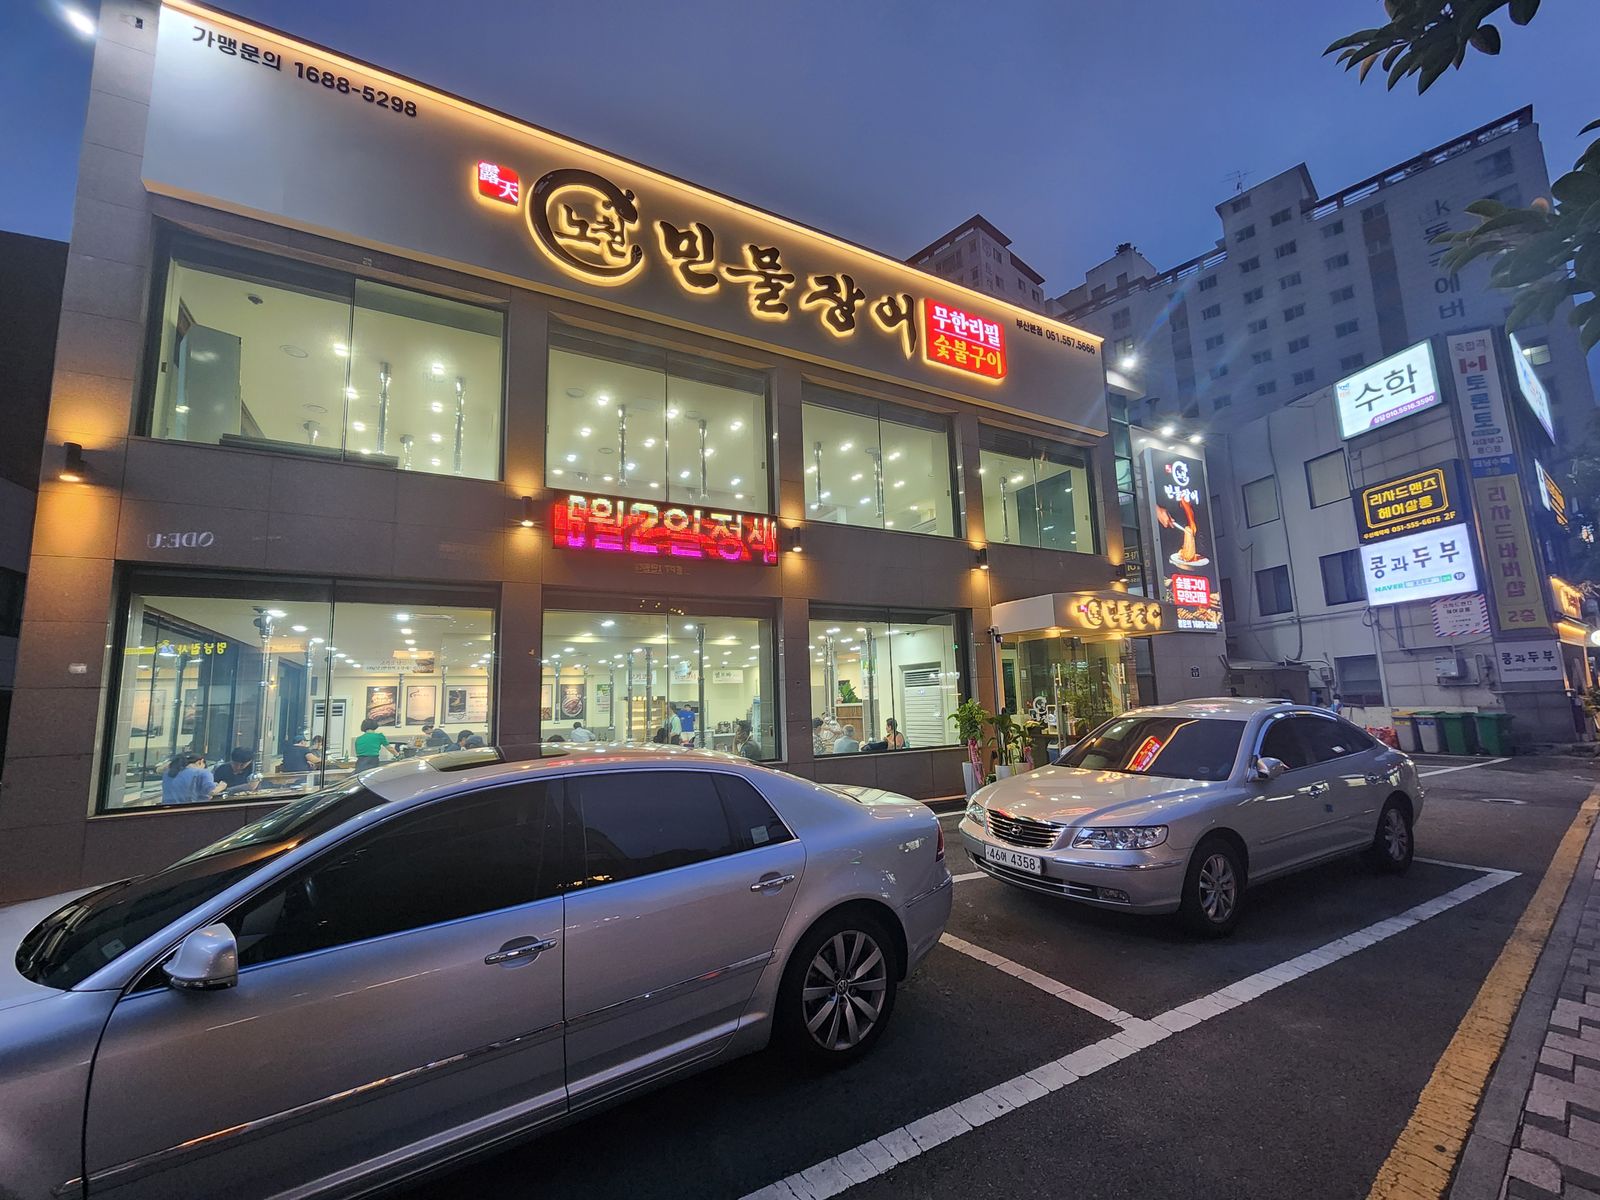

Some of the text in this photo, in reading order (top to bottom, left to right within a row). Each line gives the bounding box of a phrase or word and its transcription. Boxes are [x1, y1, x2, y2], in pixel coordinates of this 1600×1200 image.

[192, 26, 418, 118] 가맹문의 1688-5298
[932, 305, 1001, 347] 무한리필
[1016, 318, 1043, 337] 부산본점
[933, 334, 1003, 375] 숯불구이
[1355, 363, 1418, 412] 수학
[1466, 374, 1494, 429] 토론토
[1369, 477, 1438, 506] 리차드맨즈
[1444, 511, 1456, 520] 2F
[1370, 540, 1460, 579] 콩과두부
[1175, 576, 1206, 591] 숯불구이
[1375, 583, 1404, 592] NAVER
[1177, 590, 1208, 604] 무한리필
[1507, 608, 1536, 623] 2층
[1501, 650, 1555, 665] 콩과두부
[1010, 853, 1036, 870] 4358
